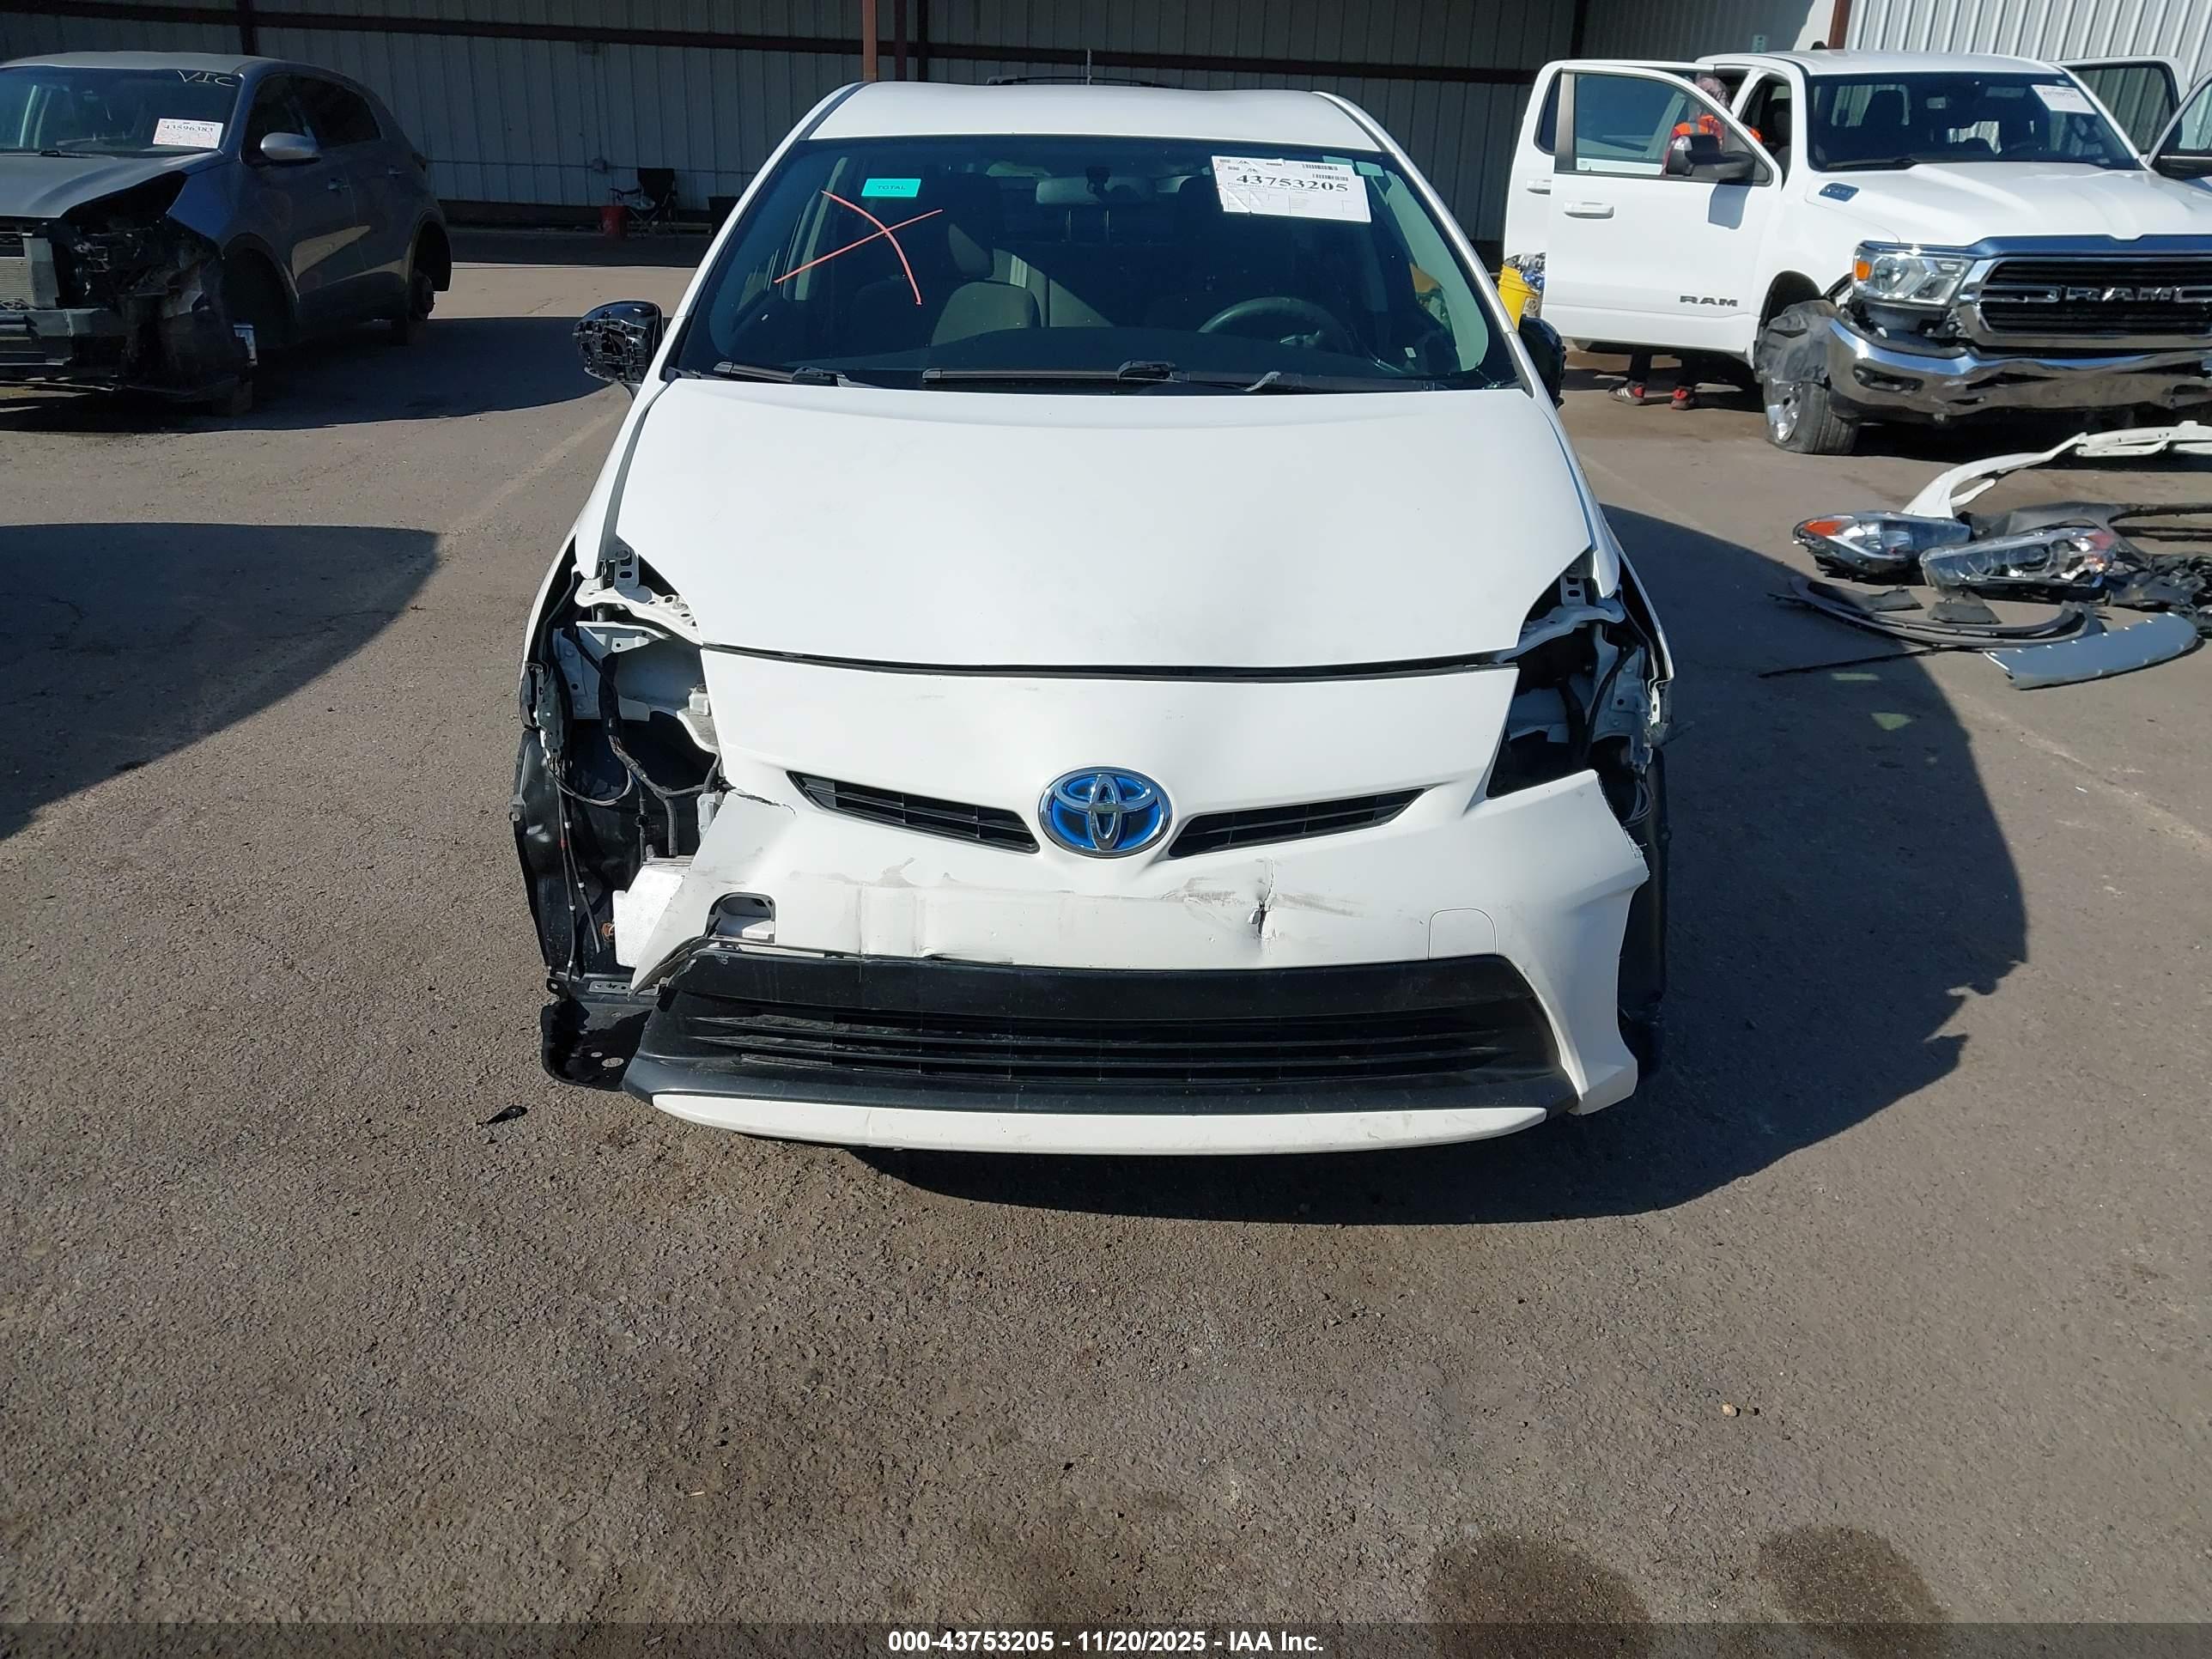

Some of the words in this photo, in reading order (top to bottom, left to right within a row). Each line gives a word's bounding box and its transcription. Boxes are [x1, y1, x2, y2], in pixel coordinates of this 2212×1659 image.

[177, 70, 236, 87] VIC
[1236, 174, 1349, 192] 43753205
[1680, 295, 1738, 307] RAM
[2066, 287, 2174, 301] RAM
